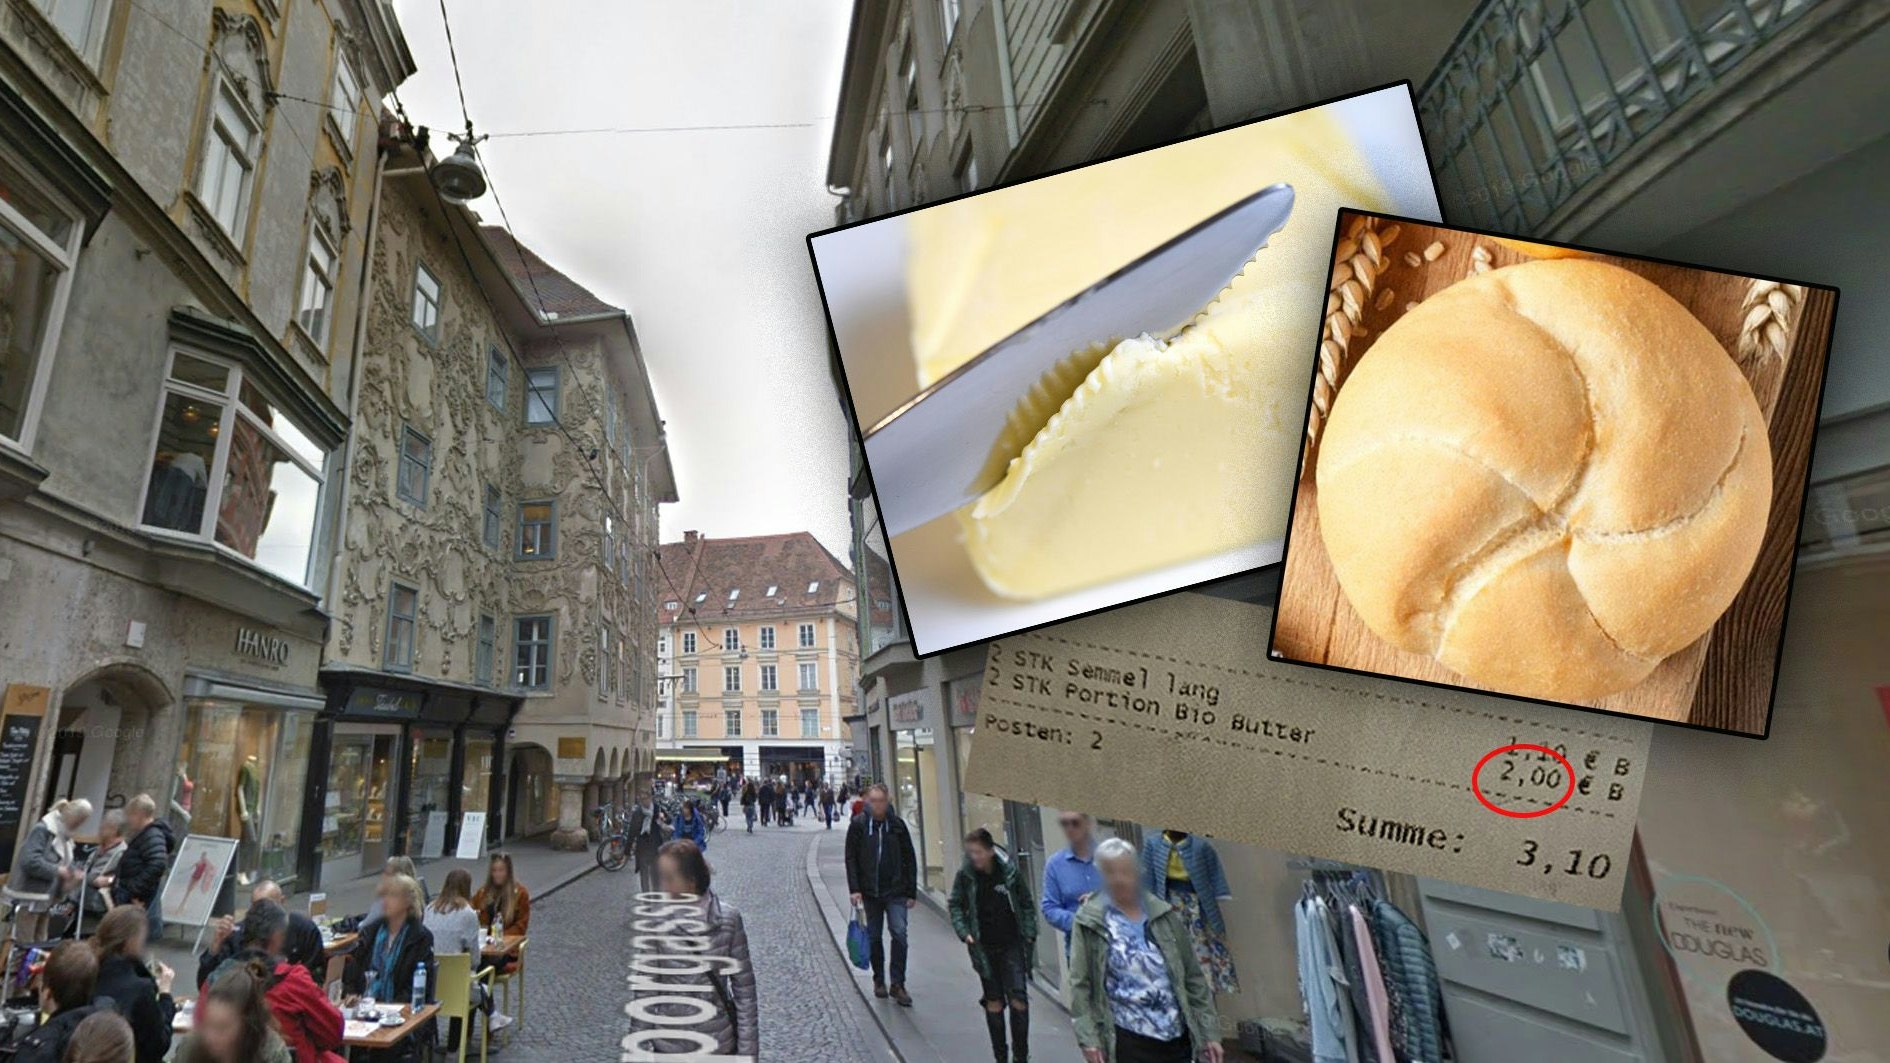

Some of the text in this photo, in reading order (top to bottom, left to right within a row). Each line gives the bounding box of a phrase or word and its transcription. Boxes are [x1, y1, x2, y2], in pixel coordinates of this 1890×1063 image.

[235, 627, 289, 665] HANRO
[990, 643, 1001, 663] 2
[1013, 650, 1053, 673] STK
[1067, 658, 1148, 690] Semmel
[1167, 672, 1220, 706] lang
[1614, 758, 1630, 776] B
[984, 713, 1103, 750] Posten: 2
[989, 666, 1000, 686] 2
[1012, 674, 1052, 696] STK
[1065, 683, 1160, 716] Portion
[1175, 702, 1216, 725] Bio
[1231, 713, 1315, 744] Butter
[1500, 760, 1562, 789] 2,00
[1607, 783, 1624, 801] B
[1336, 806, 1611, 879] Summe: 3,10
[1683, 916, 1754, 941] THE new
[1671, 931, 1768, 968] DOUGLAS
